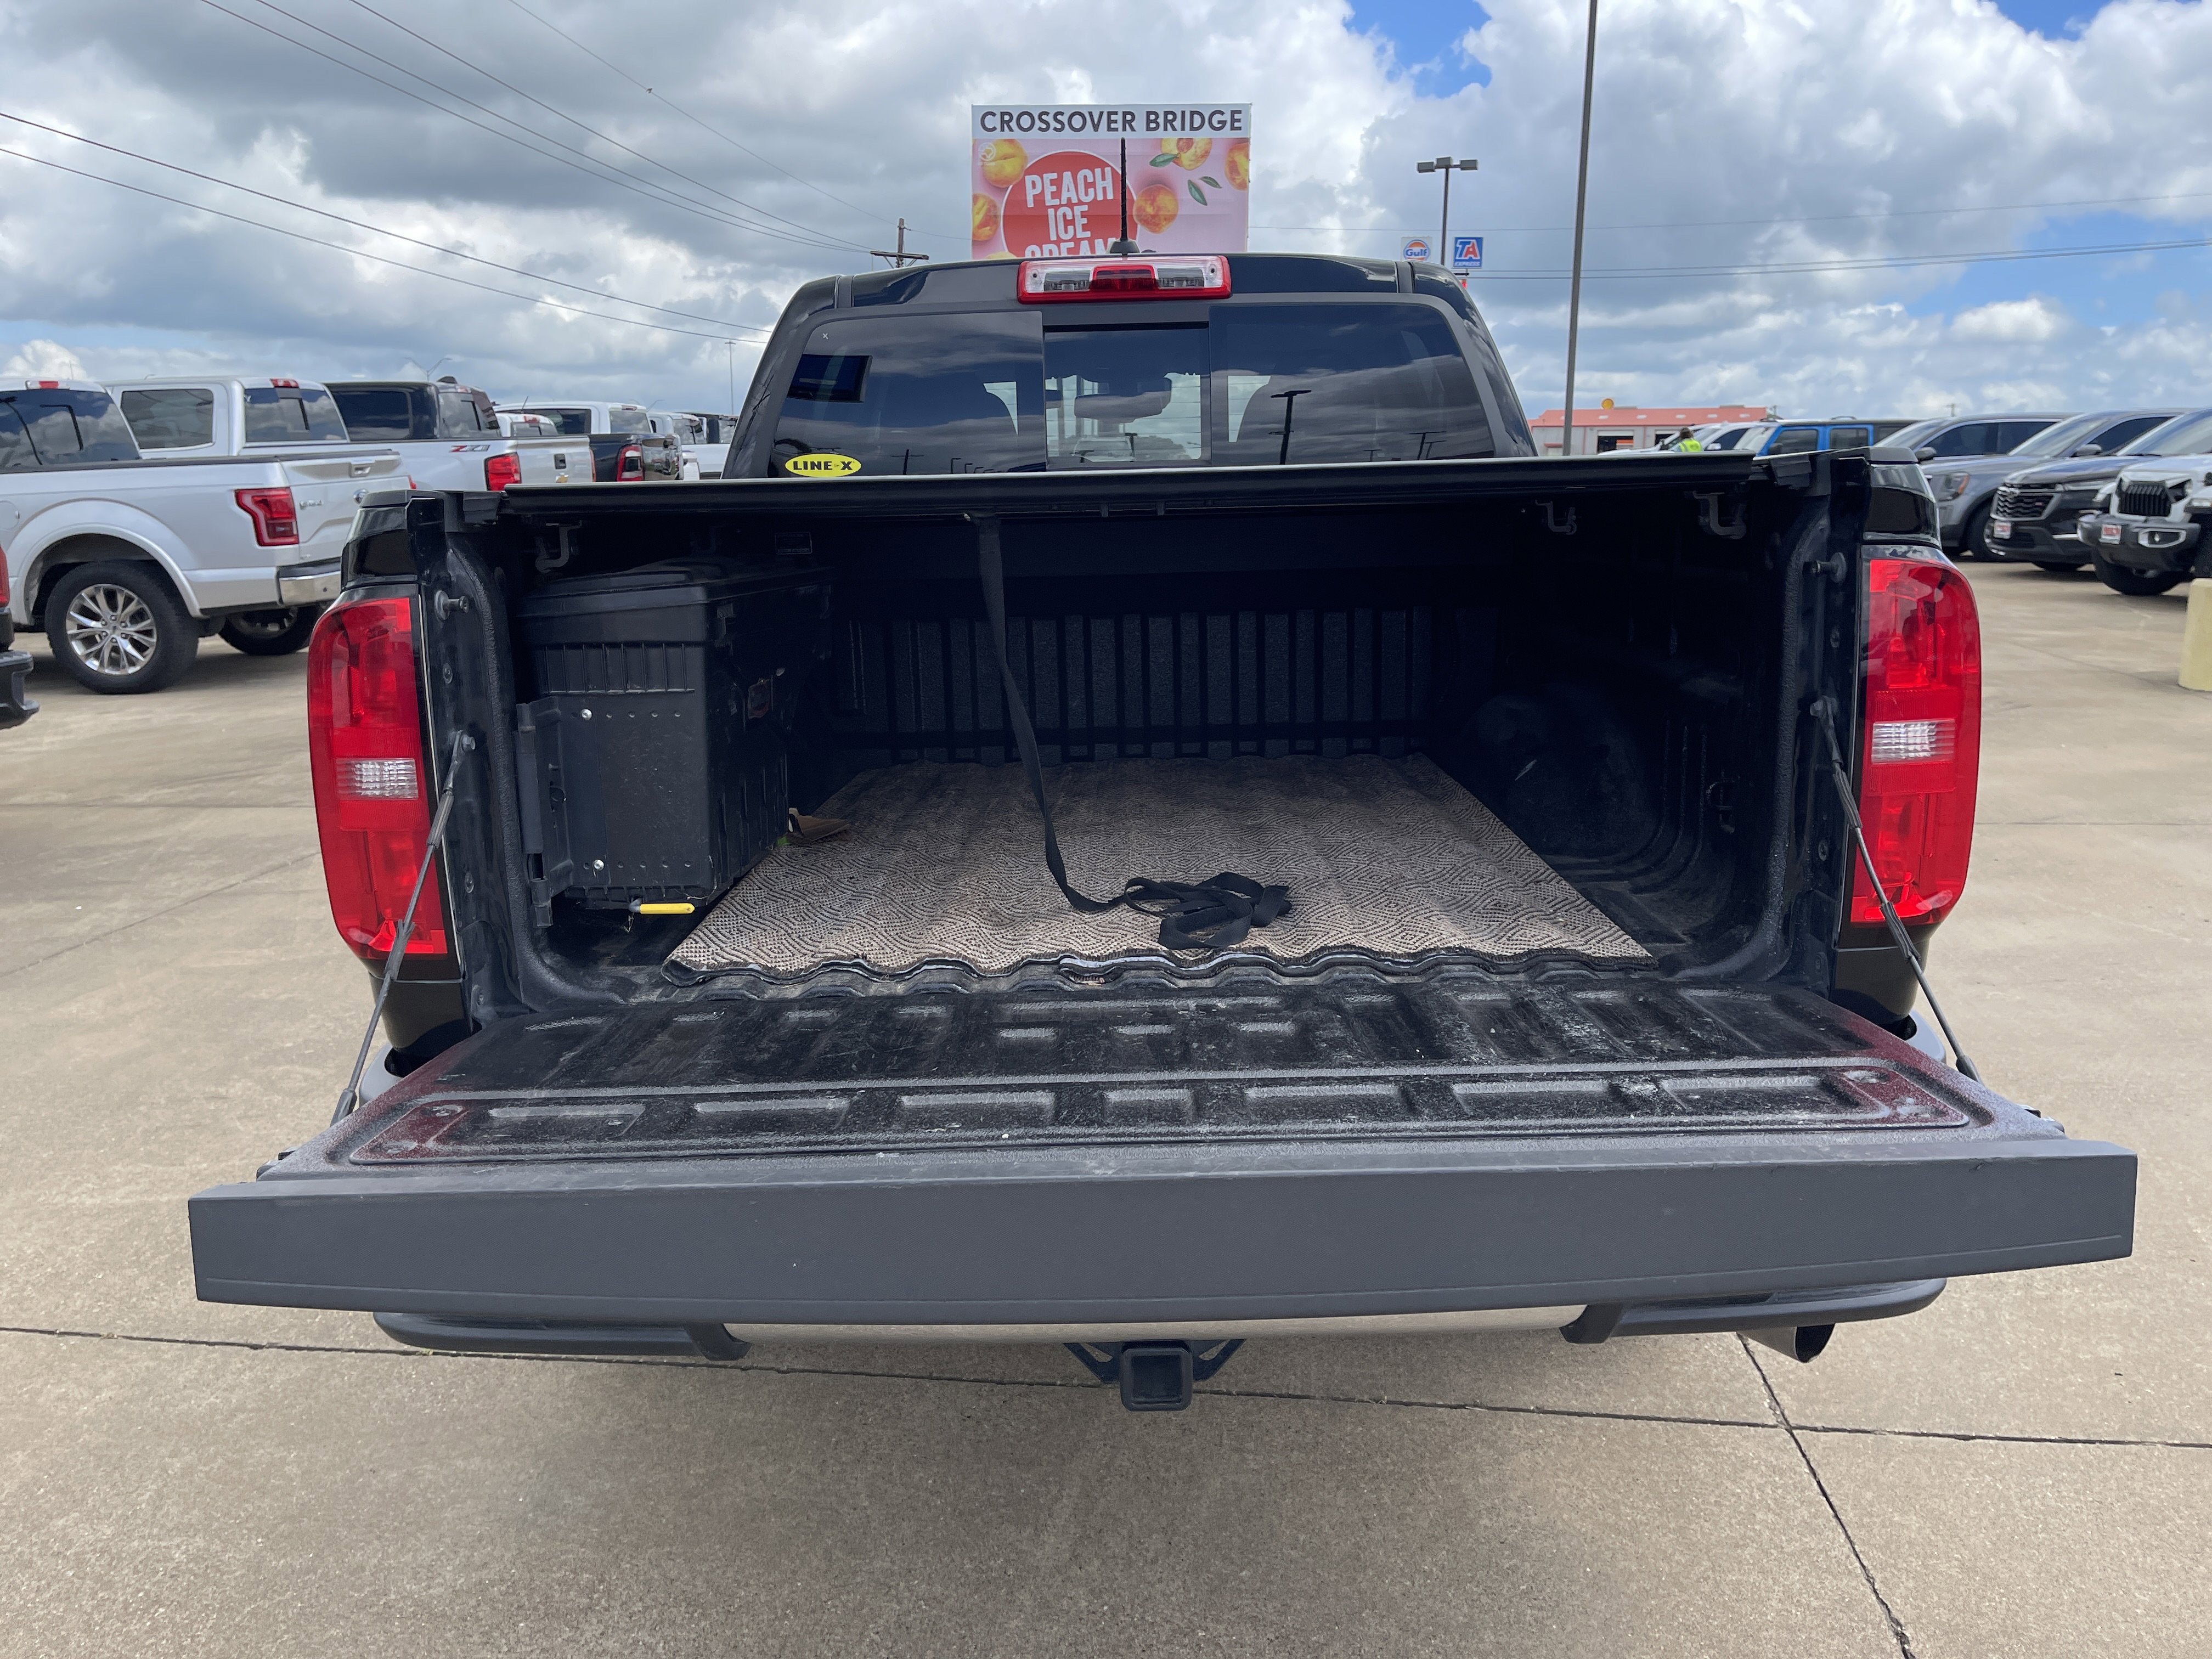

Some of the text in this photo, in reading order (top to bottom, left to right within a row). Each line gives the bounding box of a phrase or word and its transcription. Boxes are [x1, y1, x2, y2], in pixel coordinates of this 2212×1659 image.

[980, 109, 1243, 133] CROSSOVER BRIDGE
[1024, 167, 1114, 207] PEACH
[1047, 205, 1091, 241] ICE
[1456, 239, 1480, 259] TA
